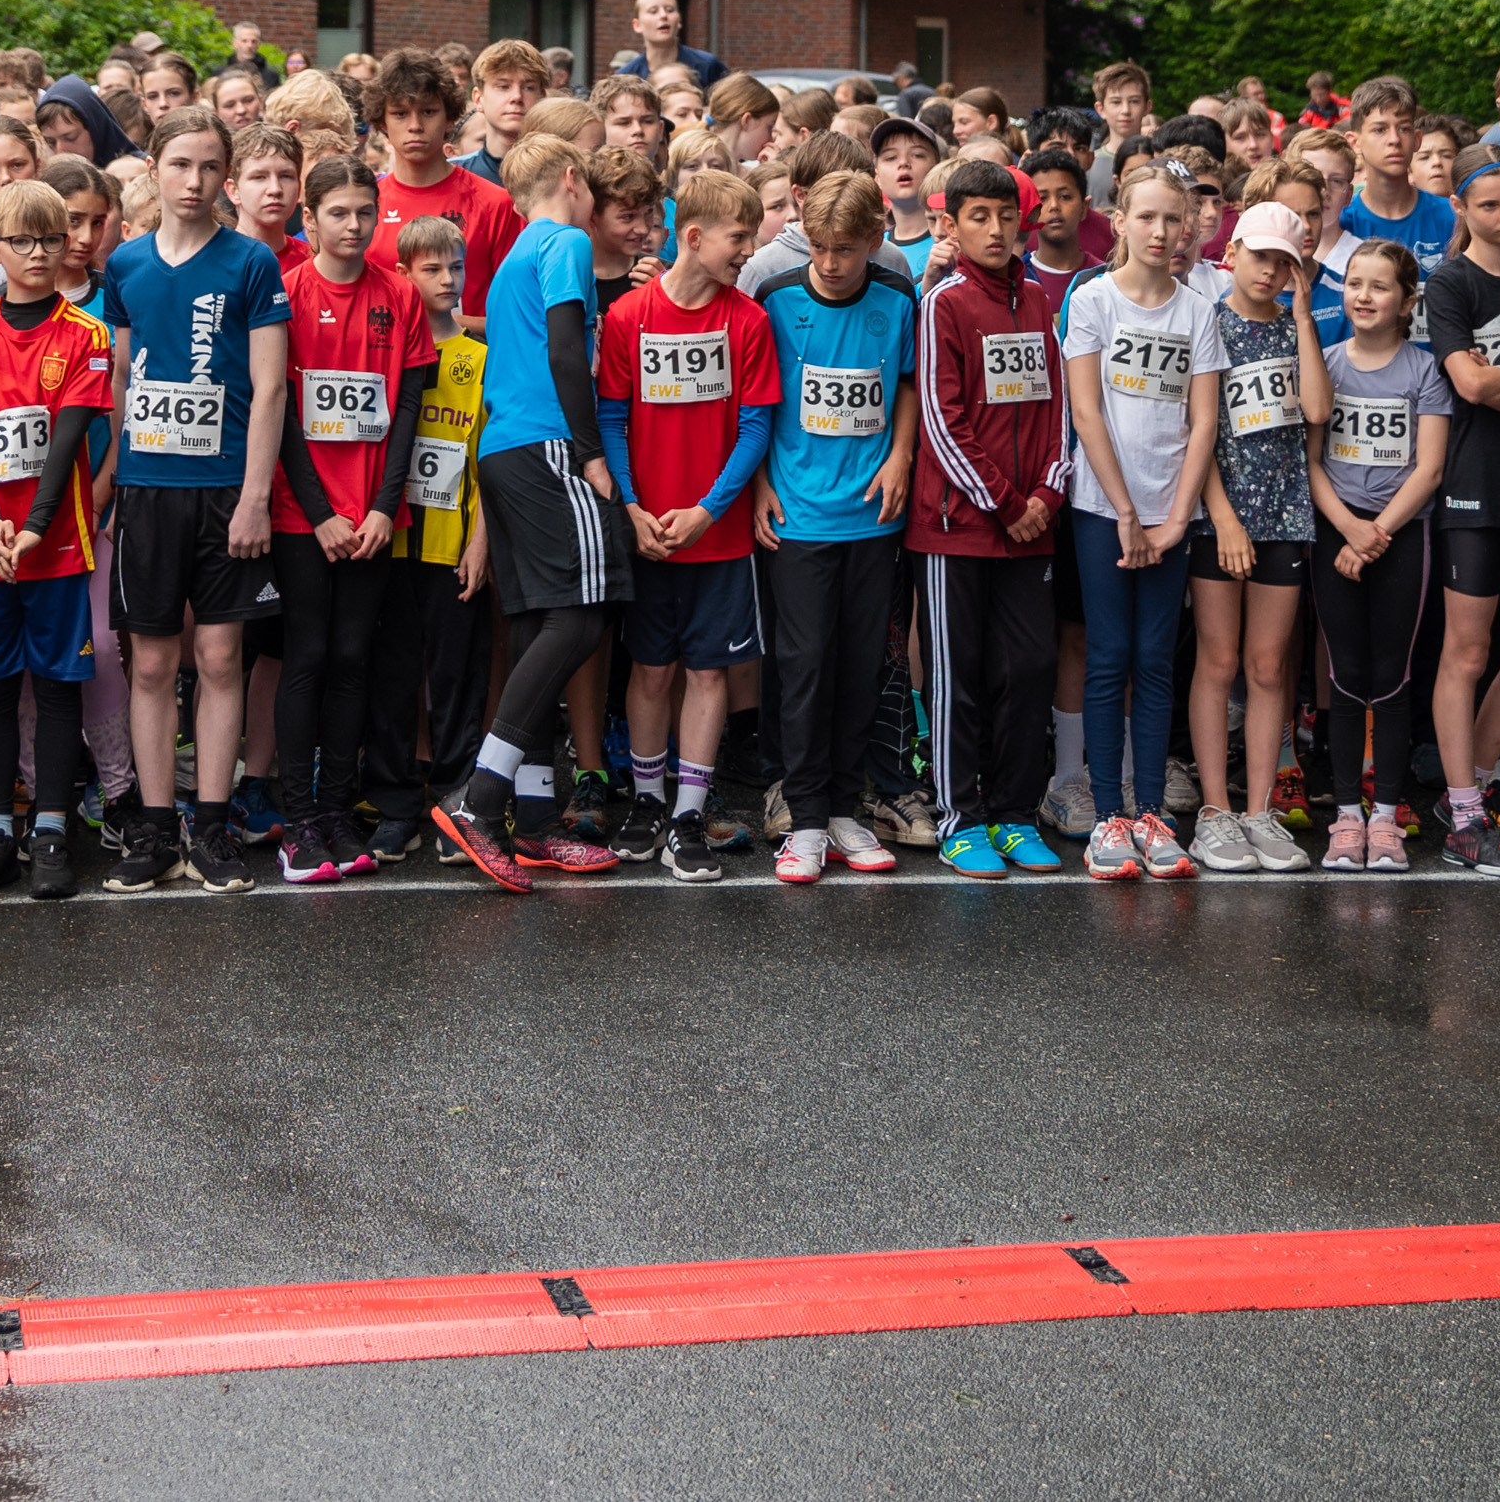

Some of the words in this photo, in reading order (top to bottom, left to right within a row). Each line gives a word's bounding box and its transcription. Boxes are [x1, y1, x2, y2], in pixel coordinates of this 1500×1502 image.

[214, 294, 226, 334] STRONG
[1119, 329, 1156, 341] Everstener
[643, 345, 725, 375] 3191
[987, 345, 1046, 375] 3383
[1110, 337, 1191, 374] 2175
[452, 362, 472, 379] BVB
[807, 370, 845, 380] Everstener
[1142, 370, 1162, 378] Laura
[309, 375, 346, 383] Everstener
[1112, 373, 1148, 391] EWE
[1159, 380, 1184, 395] bruns
[173, 388, 219, 397] Brunnenlauf
[649, 384, 682, 397] EWE
[696, 382, 725, 394] bruns
[803, 379, 883, 409] 3380
[995, 383, 1024, 397] EWE
[1226, 370, 1296, 410] 2181
[315, 384, 377, 413] 962
[133, 394, 220, 426] 3462
[423, 404, 475, 429] ONIK
[826, 407, 858, 418] Oskar
[806, 415, 841, 430] EWE
[853, 417, 880, 429] bruns
[1238, 410, 1271, 429] EWE
[1331, 407, 1406, 439] 2185
[152, 423, 184, 435] Julius
[310, 421, 345, 435] EWE
[357, 421, 383, 435] bruns
[135, 432, 167, 447] EWE
[180, 434, 212, 448] bruns
[418, 441, 461, 453] Brunnenlauf
[1333, 443, 1360, 458] EWE
[1373, 446, 1402, 459] bruns
[22, 459, 45, 471] bruns
[422, 487, 452, 501] bruns
[1445, 495, 1481, 510] OLDENBURG
